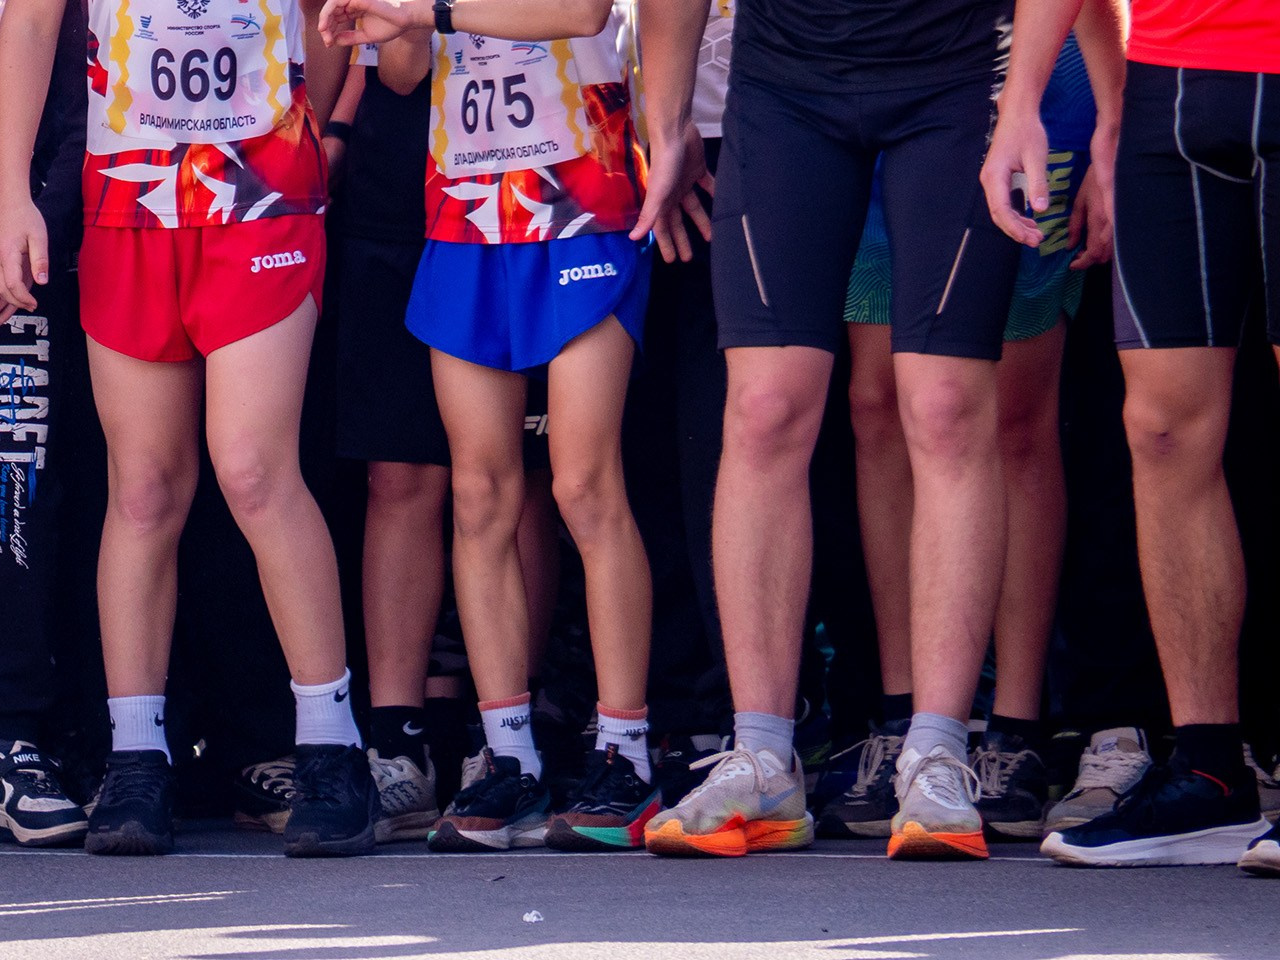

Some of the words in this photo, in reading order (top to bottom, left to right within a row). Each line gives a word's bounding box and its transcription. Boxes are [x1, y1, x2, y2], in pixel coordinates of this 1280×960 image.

[150, 46, 238, 103] 669
[461, 73, 535, 134] 675
[139, 112, 213, 132] ВЛАДИМИРСКАЯ
[213, 114, 257, 130] ОБЛАСТЬ
[454, 146, 516, 166] ВЛАДИМИРСКАЯ
[516, 140, 559, 158] ОБЛАСТЬ
[13, 753, 41, 764] NIKE
